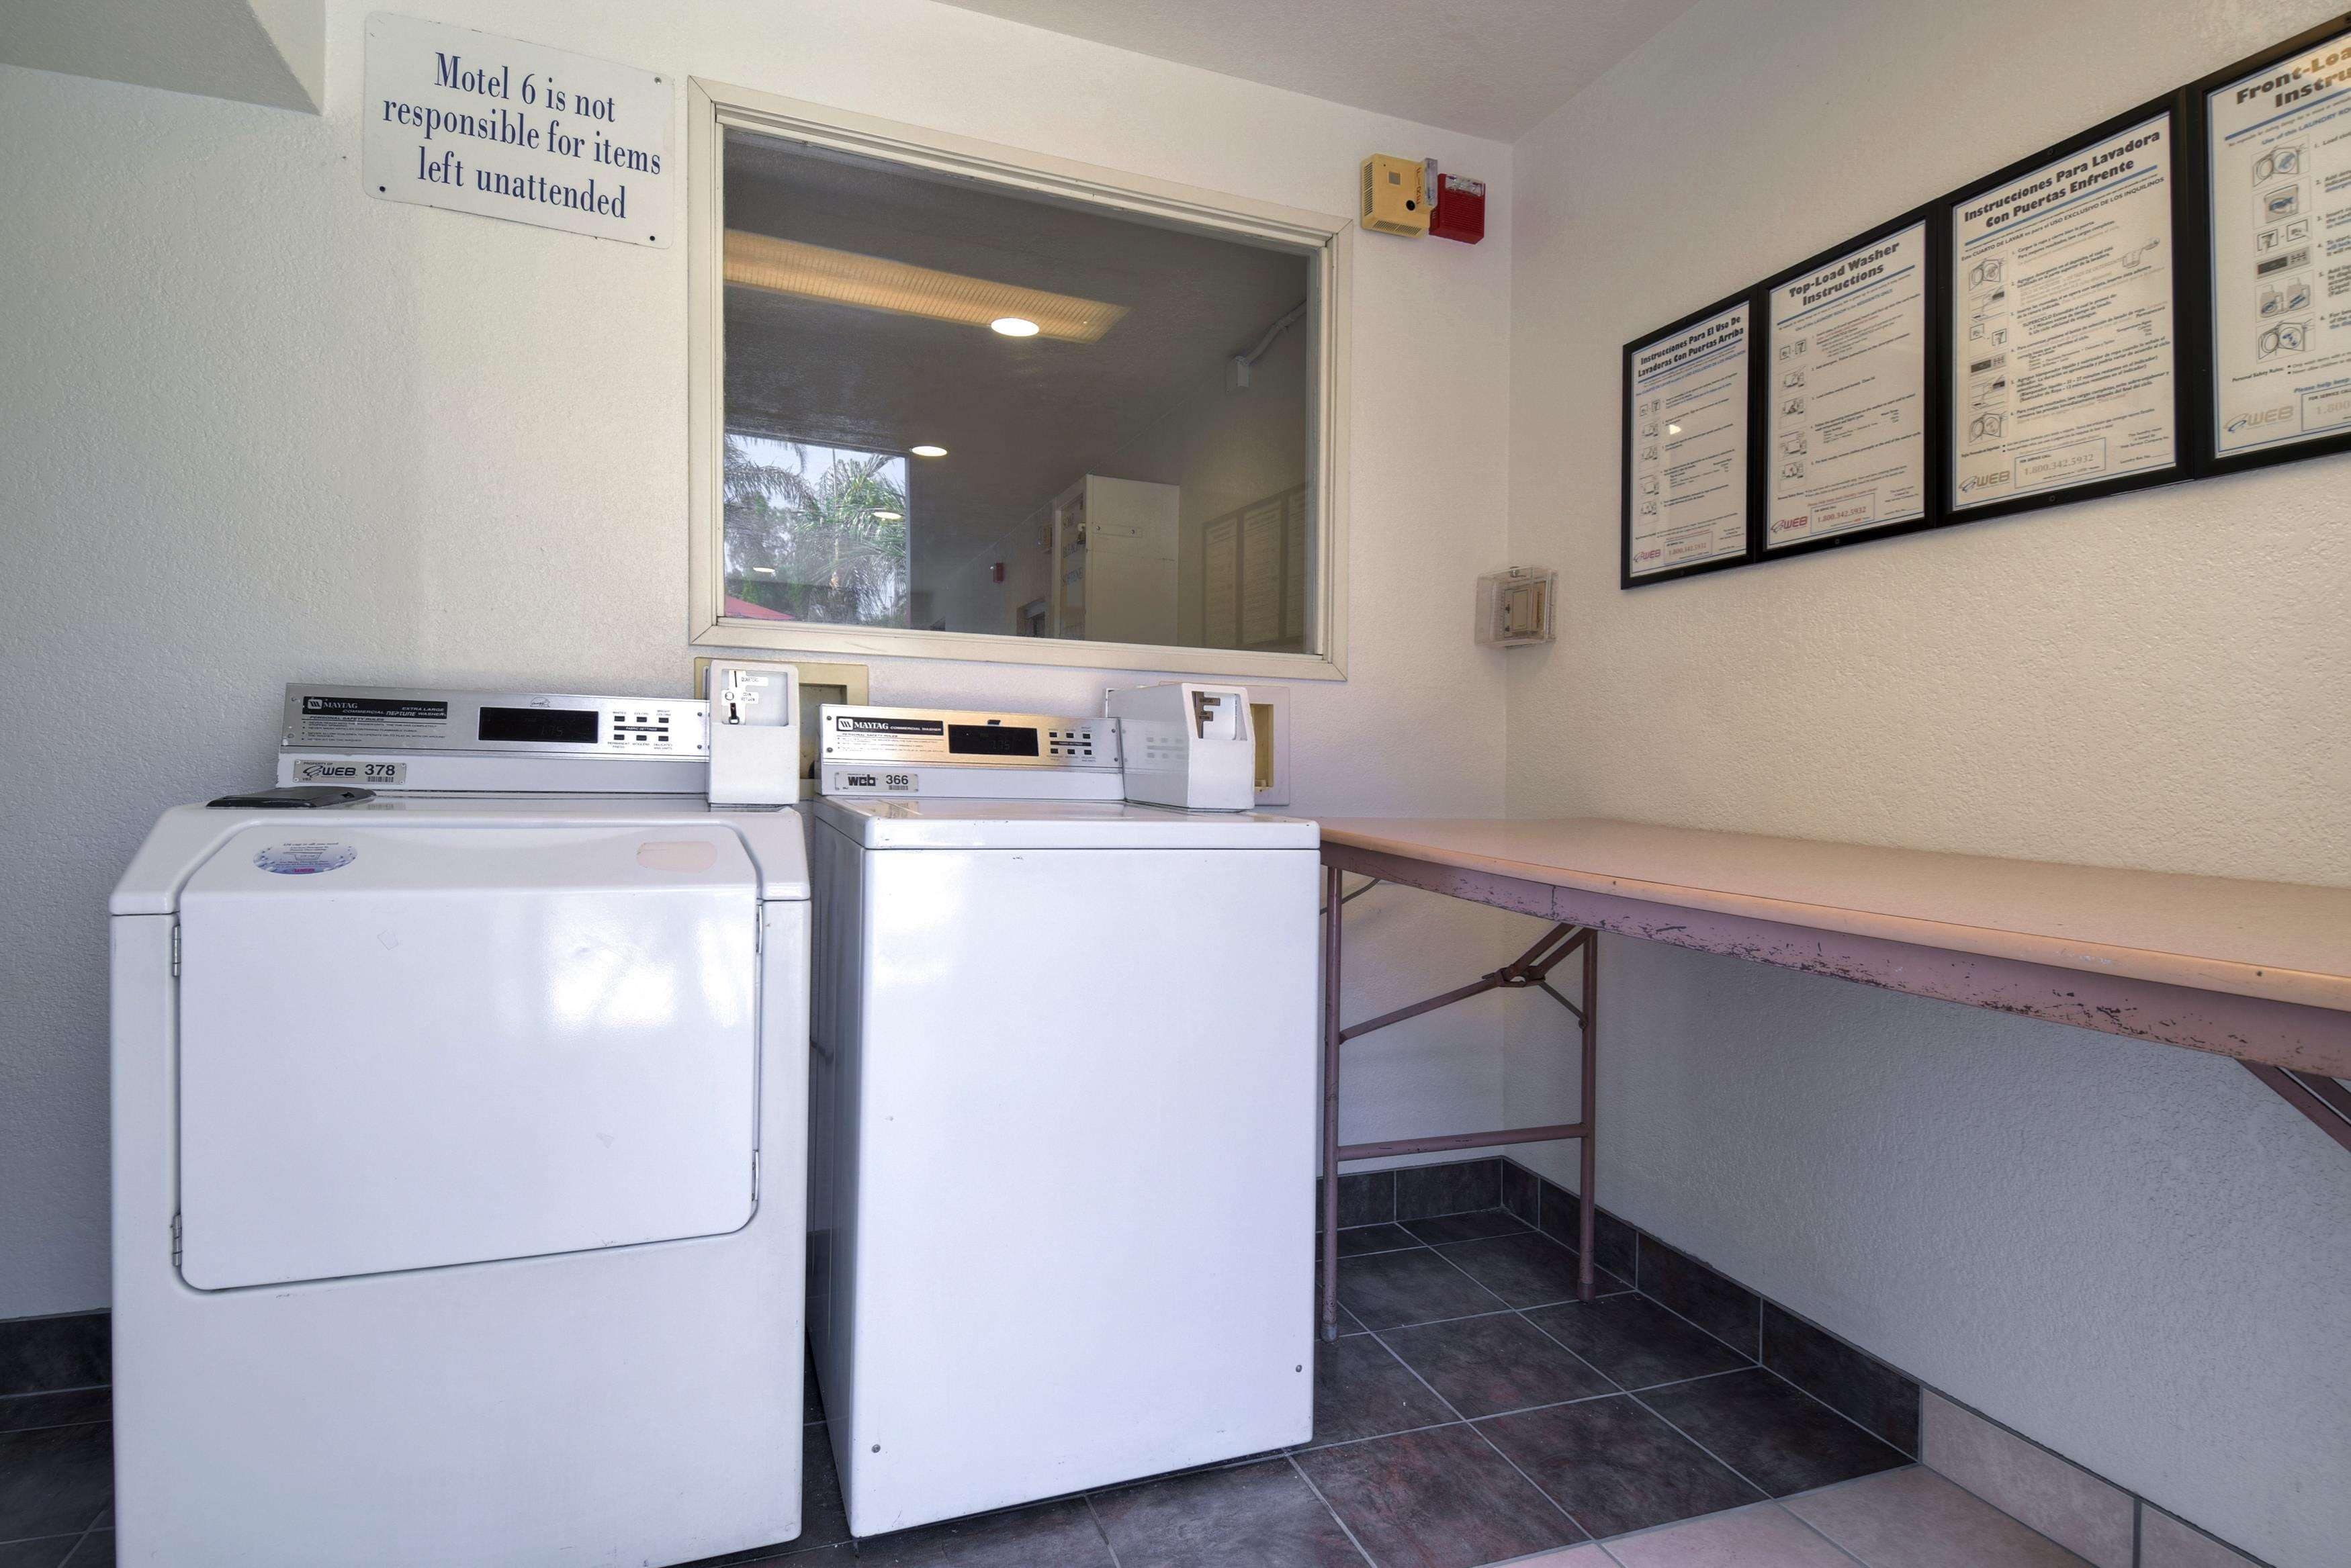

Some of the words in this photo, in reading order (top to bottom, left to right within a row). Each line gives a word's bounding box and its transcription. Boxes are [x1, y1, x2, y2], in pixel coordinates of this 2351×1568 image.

[435, 52, 509, 99] Motel
[522, 73, 536, 104] 6
[546, 78, 566, 111] is
[576, 93, 615, 122] not
[383, 99, 539, 149] responsible
[547, 120, 584, 158] for
[594, 131, 661, 175] items
[2299, 112, 2336, 130] LAUNDRY
[418, 146, 464, 187] left
[476, 169, 626, 218] unattended
[1965, 177, 2052, 222] Instrucciones
[2056, 161, 2088, 183] Para
[2092, 132, 2160, 167] Lavadora
[1986, 212, 2009, 228] Con
[2013, 189, 2066, 217] Puertas
[2070, 159, 2134, 193] Enfrente
[1972, 243, 1995, 257] CUARTO
[2005, 232, 2023, 244] LAVAR
[2050, 216, 2063, 226] USO
[2064, 203, 2098, 221] EXCLUSIVO
[2100, 199, 2109, 207] DE
[2110, 193, 2123, 203] LOS
[2124, 177, 2164, 197] INQUILINOS
[1789, 265, 1845, 297] Top-Load
[1848, 242, 1900, 271] Washer
[1803, 264, 1884, 306] Instructions
[1638, 358, 1672, 377] Lavadoras
[1674, 351, 1687, 363] Con
[1689, 338, 1717, 356] Puertas
[1718, 328, 1744, 344] Arriba
[1640, 340, 1687, 365] Instrucciones
[1689, 332, 1705, 344] Para
[1707, 327, 1714, 336] El
[1716, 321, 1729, 332] Uso
[1731, 316, 1740, 325] De
[2247, 406, 2293, 426] WEB
[1977, 470, 2010, 488] WEB
[2023, 453, 2094, 475] 1.800.342.5932
[1783, 516, 1808, 529] WEB
[1818, 506, 1866, 522] 1.800.342.5932
[1644, 549, 1660, 560] WEB
[854, 721, 889, 729] MAYTAG
[322, 767, 356, 776] WEB
[365, 764, 396, 776] 378
[848, 774, 876, 786] web
[885, 775, 908, 784] 366
